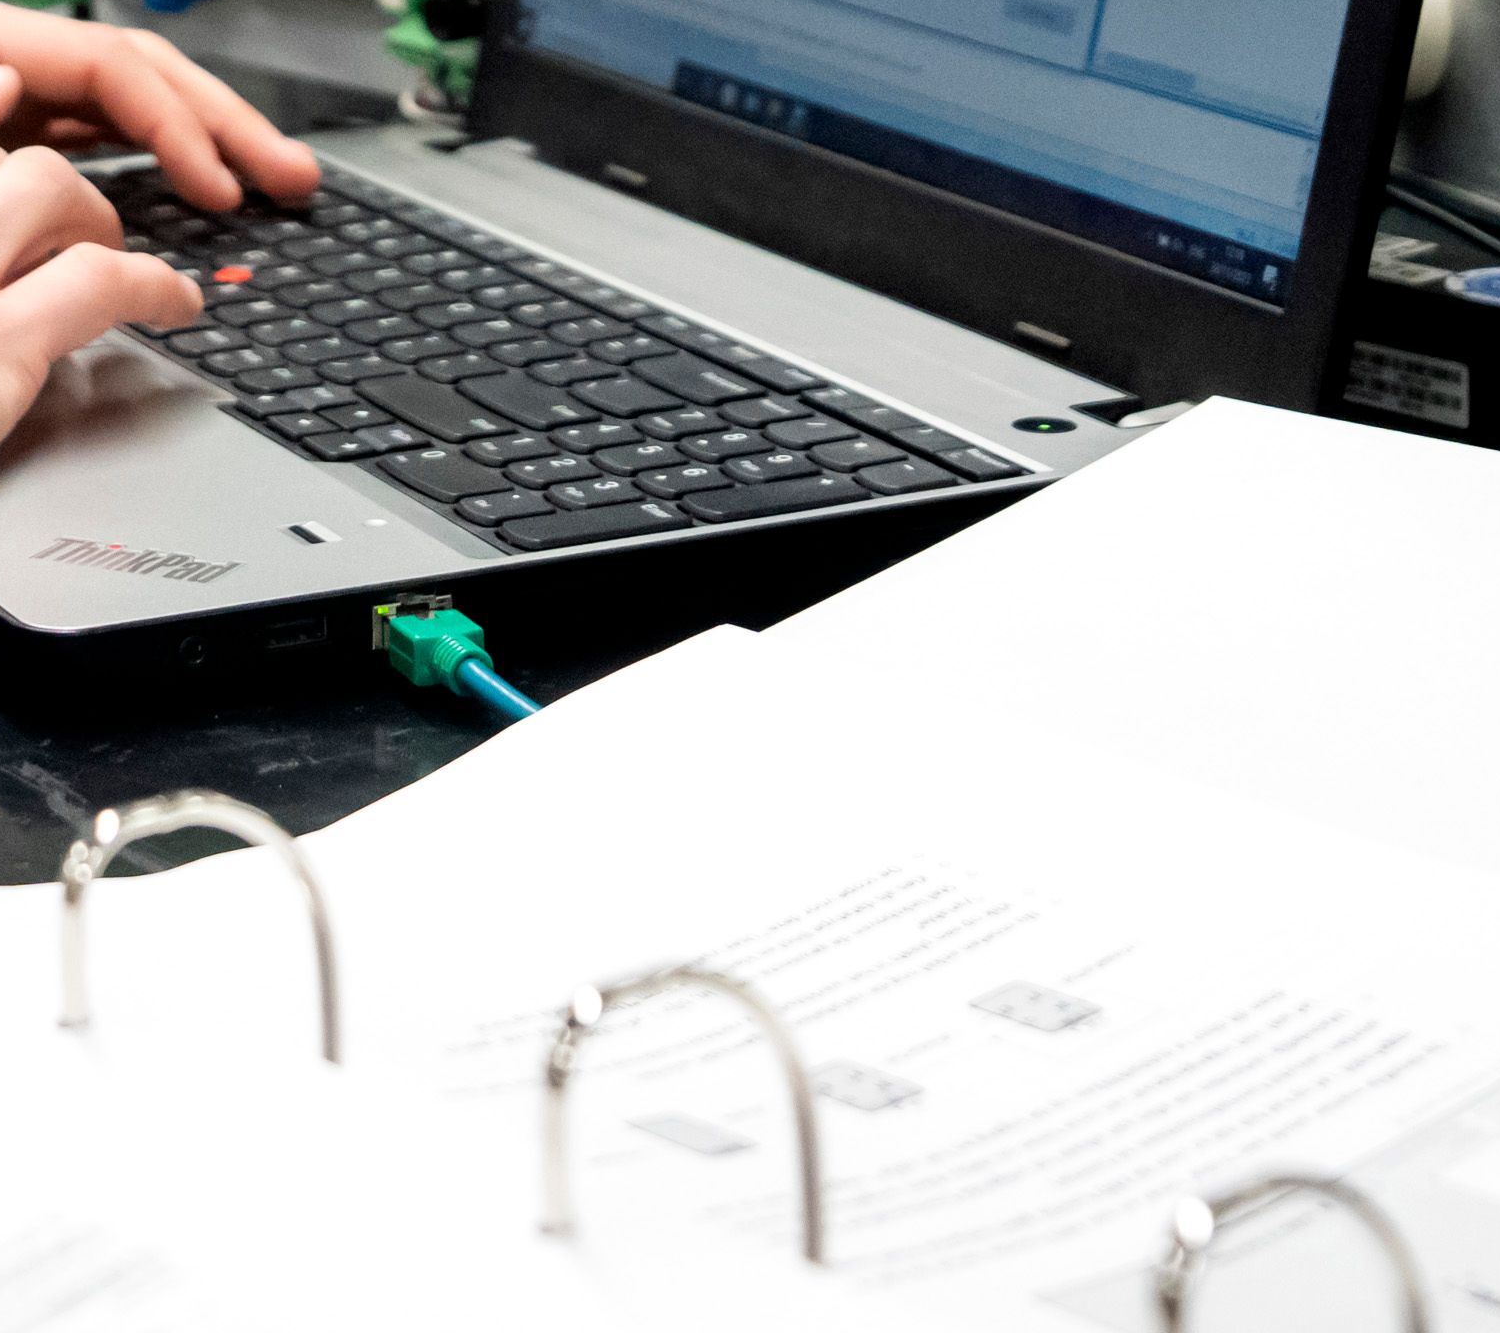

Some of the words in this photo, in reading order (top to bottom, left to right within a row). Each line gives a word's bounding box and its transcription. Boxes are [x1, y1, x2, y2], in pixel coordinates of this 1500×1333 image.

[721, 432, 748, 442] 8
[636, 445, 663, 455] 5
[549, 458, 577, 468] 2
[766, 454, 793, 464] 9
[682, 468, 709, 477] 6
[593, 481, 619, 491] 3
[29, 537, 248, 583] ThinkPad
